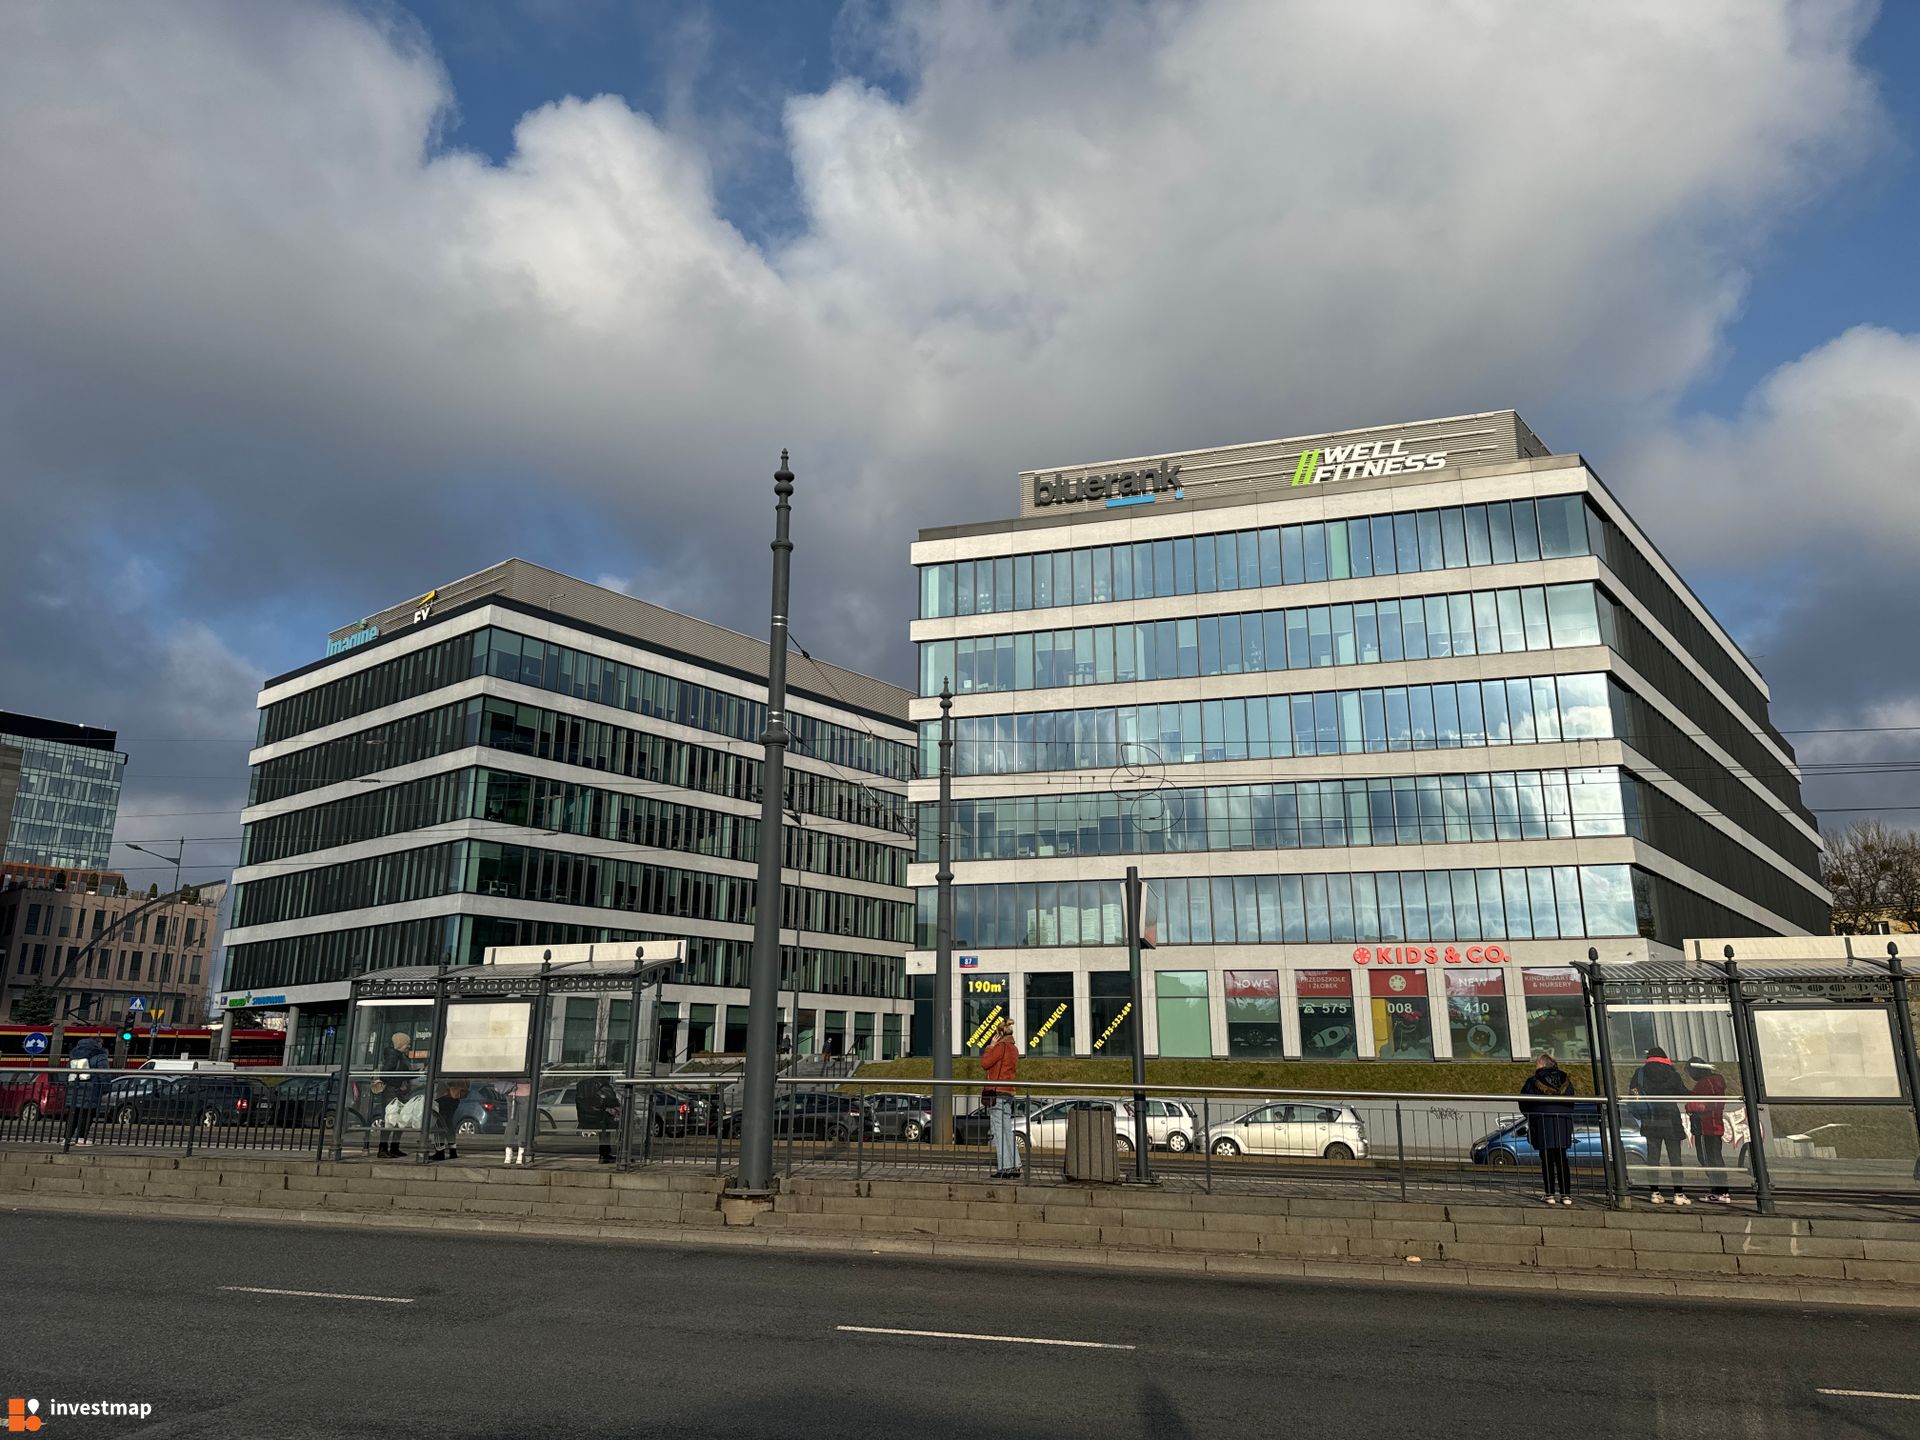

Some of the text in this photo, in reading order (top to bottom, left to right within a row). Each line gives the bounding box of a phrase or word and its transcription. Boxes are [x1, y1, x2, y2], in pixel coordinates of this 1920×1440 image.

[1324, 439, 1410, 464] WELL
[1312, 452, 1448, 485] FITNESS
[1032, 460, 1183, 507] bluerank
[1376, 946, 1439, 964] KIDS
[1444, 946, 1461, 963] &
[1458, 977, 1488, 987] NEW
[1322, 1002, 1489, 1014] 575 008 410
[1029, 1036, 1040, 1048] DO
